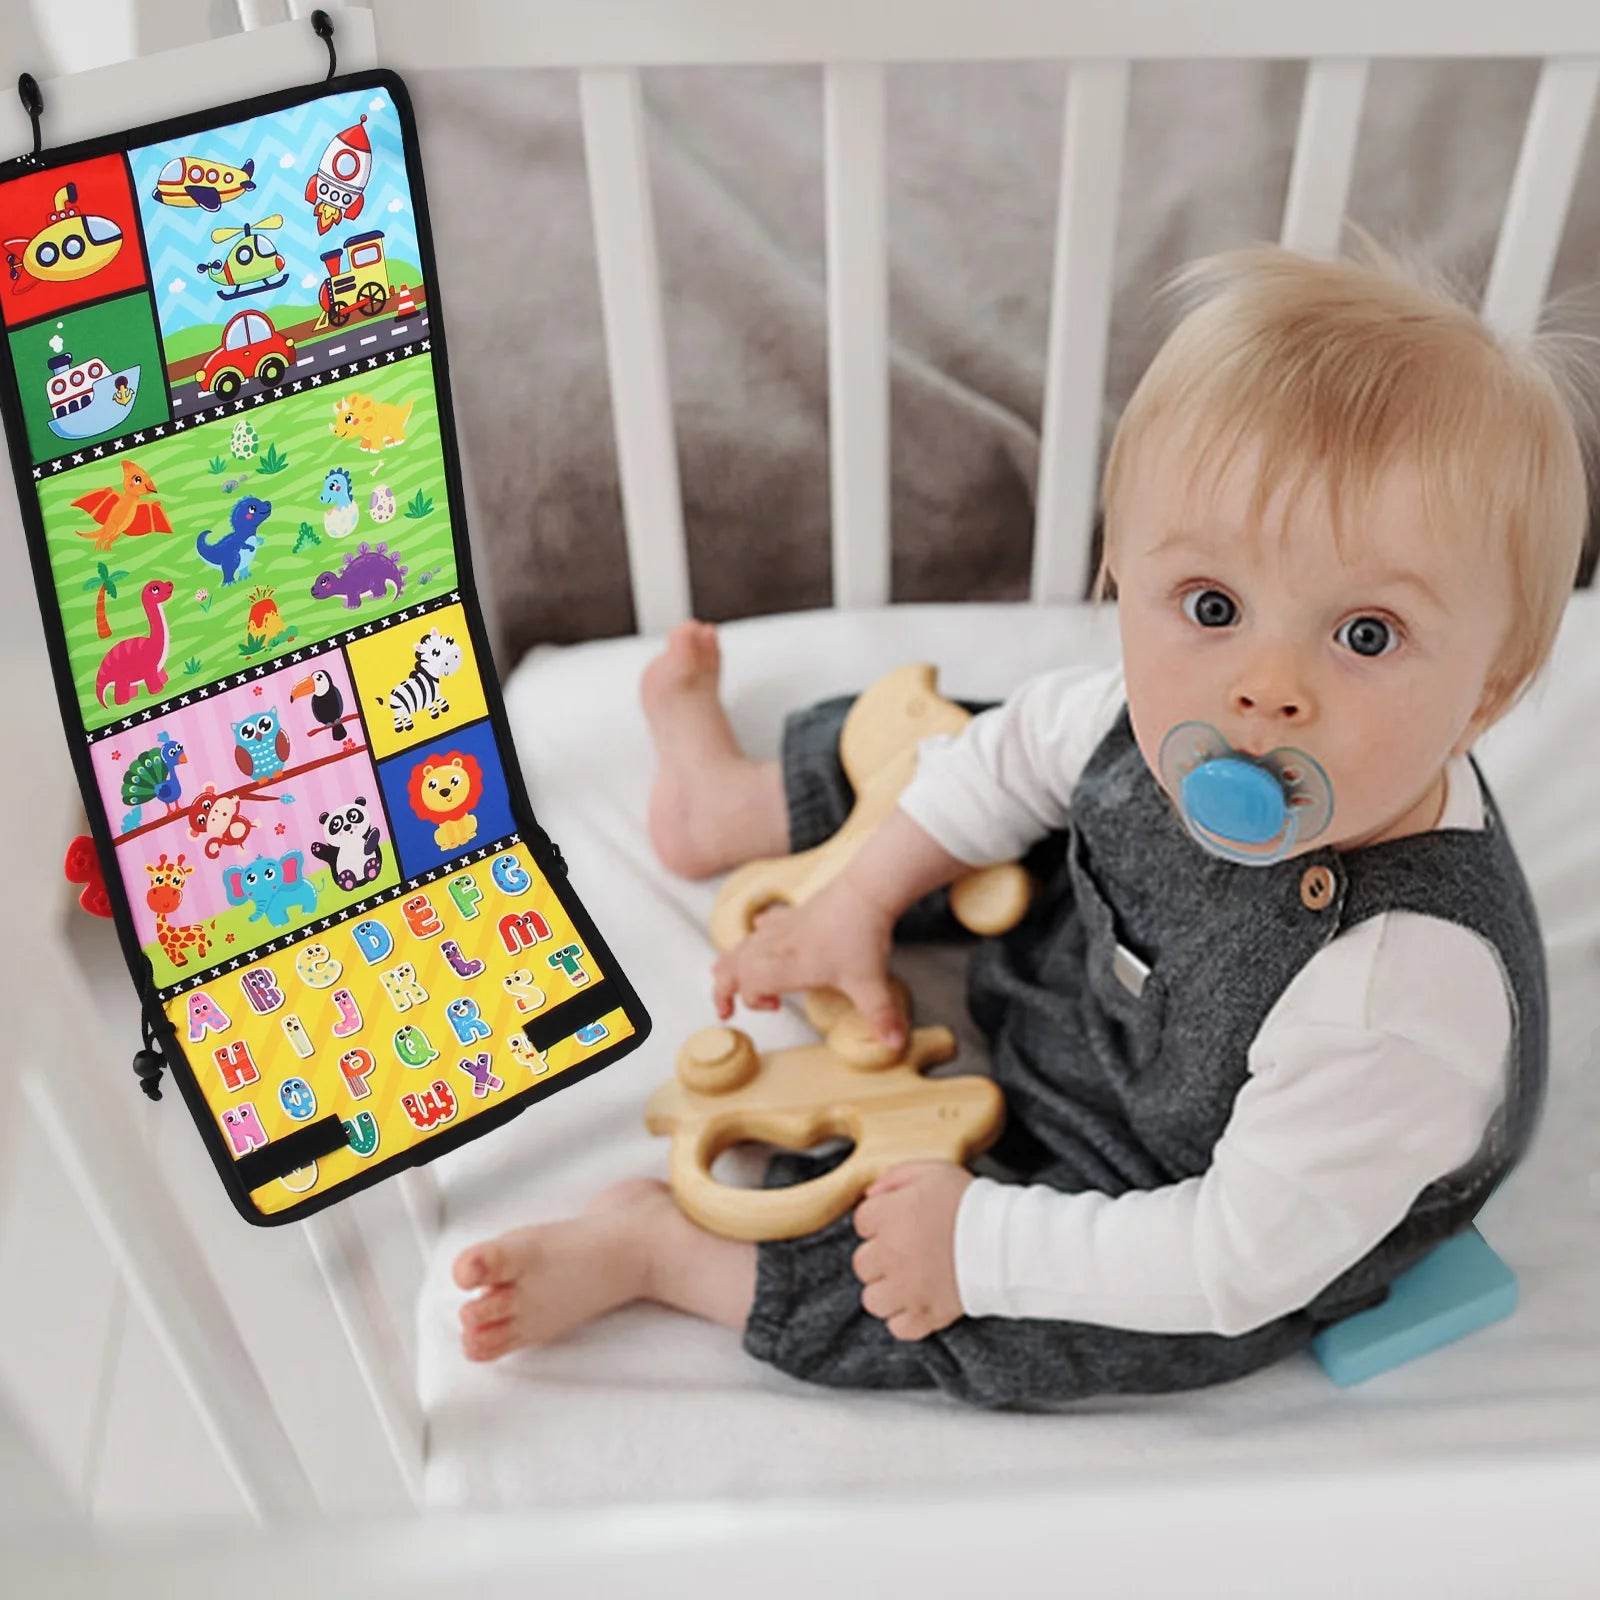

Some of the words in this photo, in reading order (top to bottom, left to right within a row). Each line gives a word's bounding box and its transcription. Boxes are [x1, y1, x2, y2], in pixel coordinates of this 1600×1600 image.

[188, 992, 231, 1042] A
[240, 967, 285, 1014] B
[296, 944, 342, 987] C
[352, 920, 393, 964] D
[401, 895, 443, 939] E
[448, 874, 481, 920] F
[491, 855, 531, 895] G
[214, 1040, 260, 1092] H
[281, 1015, 314, 1058] I
[331, 987, 364, 1037] J
[440, 940, 485, 979] L
[277, 1077, 316, 1120] O
[339, 1049, 374, 1099] P
[393, 1025, 438, 1068] Q
[446, 998, 492, 1045] R
[503, 969, 545, 1014] S
[546, 944, 590, 987] T
[459, 1053, 503, 1096] X
